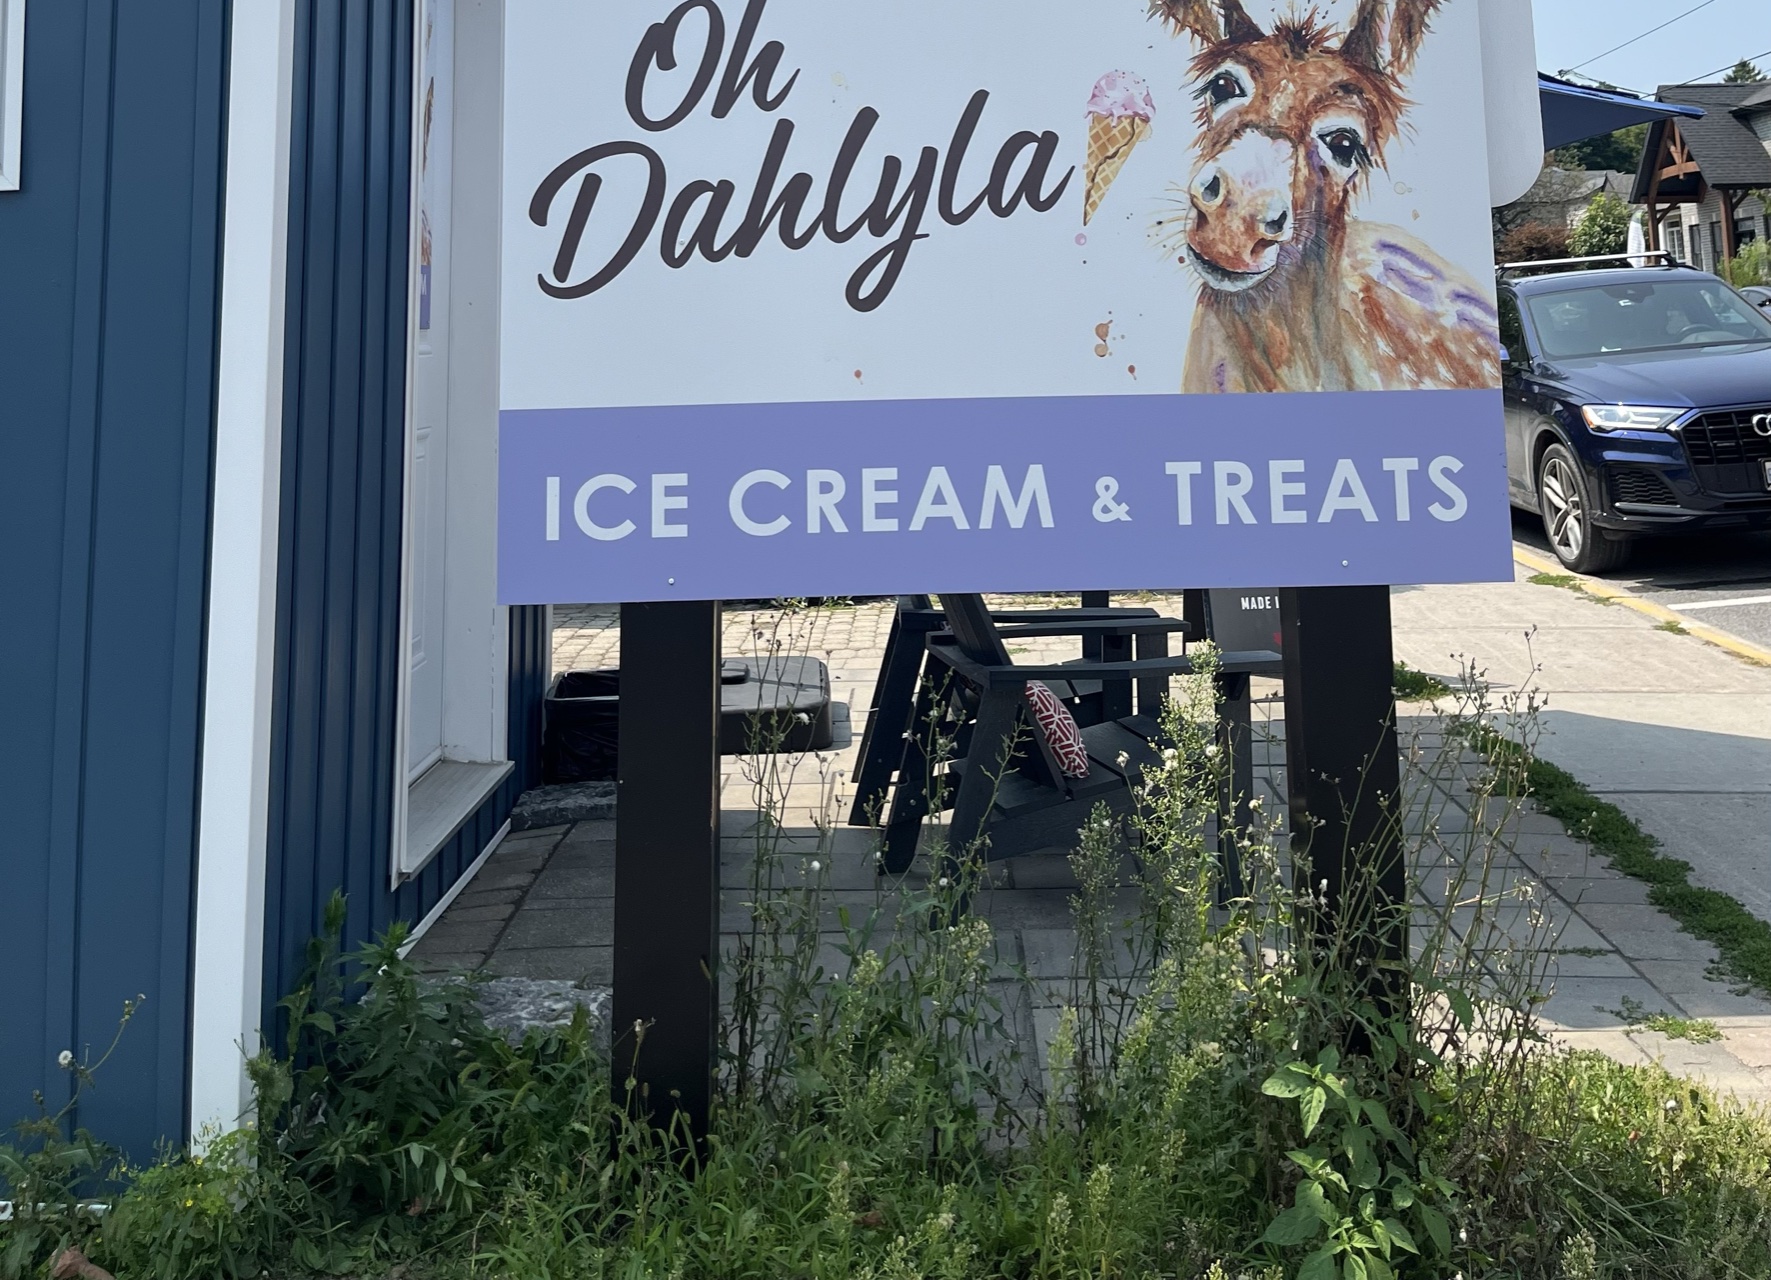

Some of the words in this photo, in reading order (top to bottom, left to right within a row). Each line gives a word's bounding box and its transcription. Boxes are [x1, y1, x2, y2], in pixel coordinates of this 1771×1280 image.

[528, 88, 1076, 313] Dahlyla
[546, 472, 689, 541] ICE
[728, 464, 1055, 537] CREAM
[1092, 476, 1133, 523] &
[1165, 455, 1468, 526] TREATS
[1241, 596, 1272, 610] MADE
